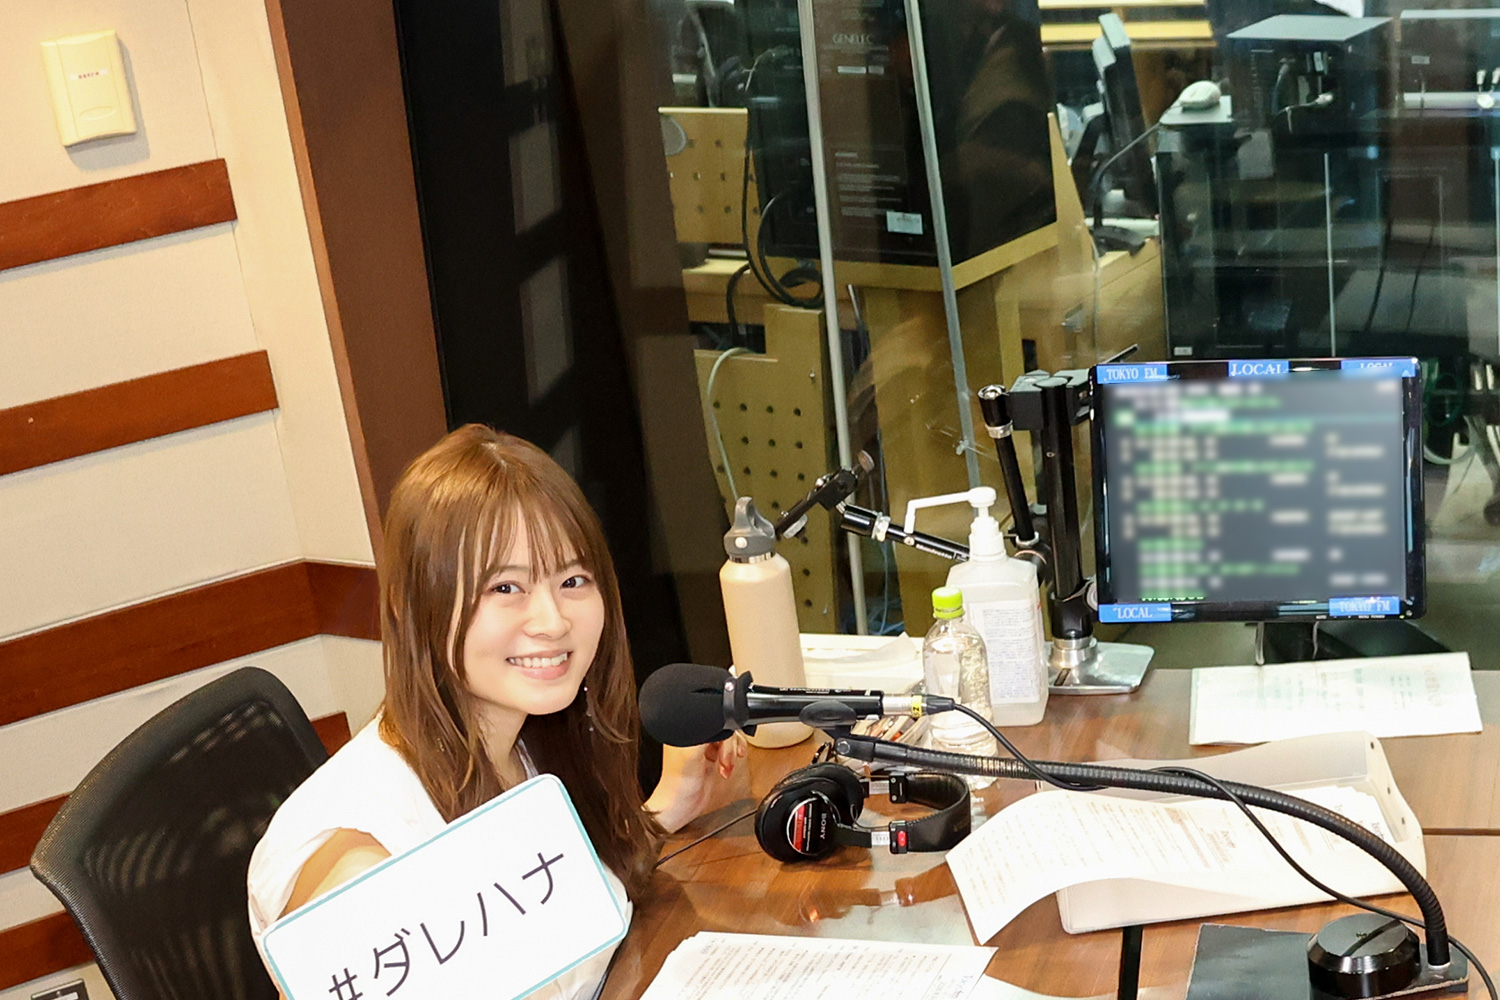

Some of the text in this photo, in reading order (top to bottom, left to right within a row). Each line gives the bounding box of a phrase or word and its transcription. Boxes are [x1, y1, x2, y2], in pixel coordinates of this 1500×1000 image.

[1106, 367, 1139, 381] TOKYO
[1231, 363, 1287, 377] LOCAL
[1116, 607, 1153, 619] LOCAL
